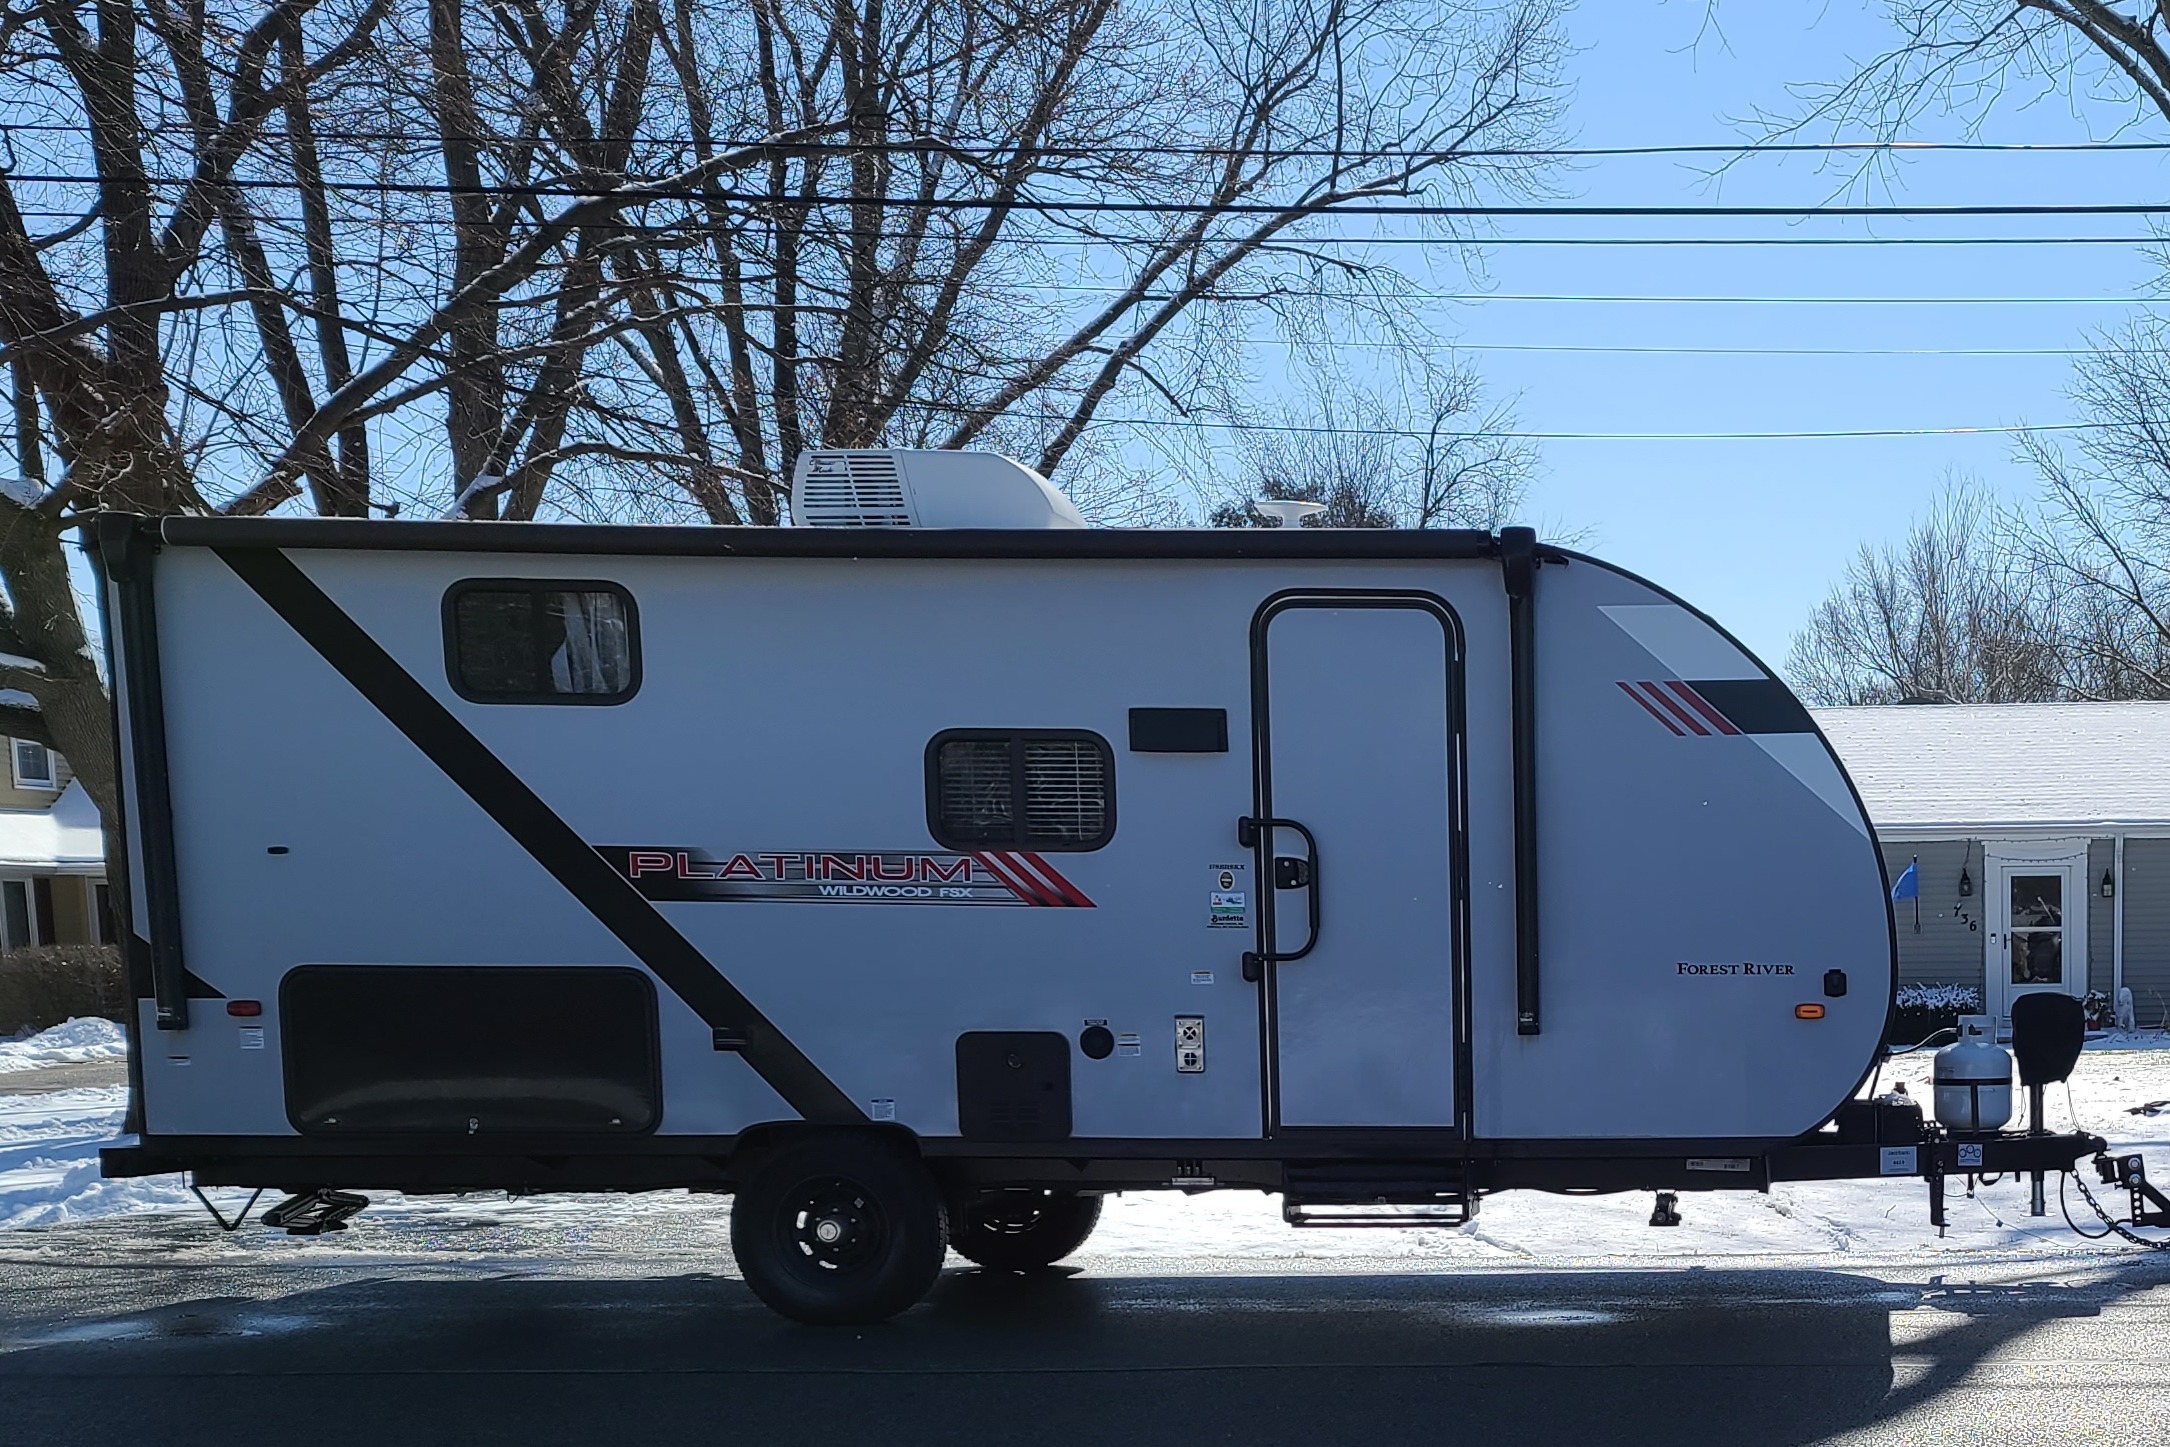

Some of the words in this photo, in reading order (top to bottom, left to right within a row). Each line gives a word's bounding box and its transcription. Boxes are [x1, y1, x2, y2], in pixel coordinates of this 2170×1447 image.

[629, 851, 973, 884] PLATINUM
[819, 885, 932, 897] WILDWOOD
[939, 887, 973, 898] FSX
[1677, 962, 1740, 975] FOREST
[1743, 962, 1795, 975] RIVER
